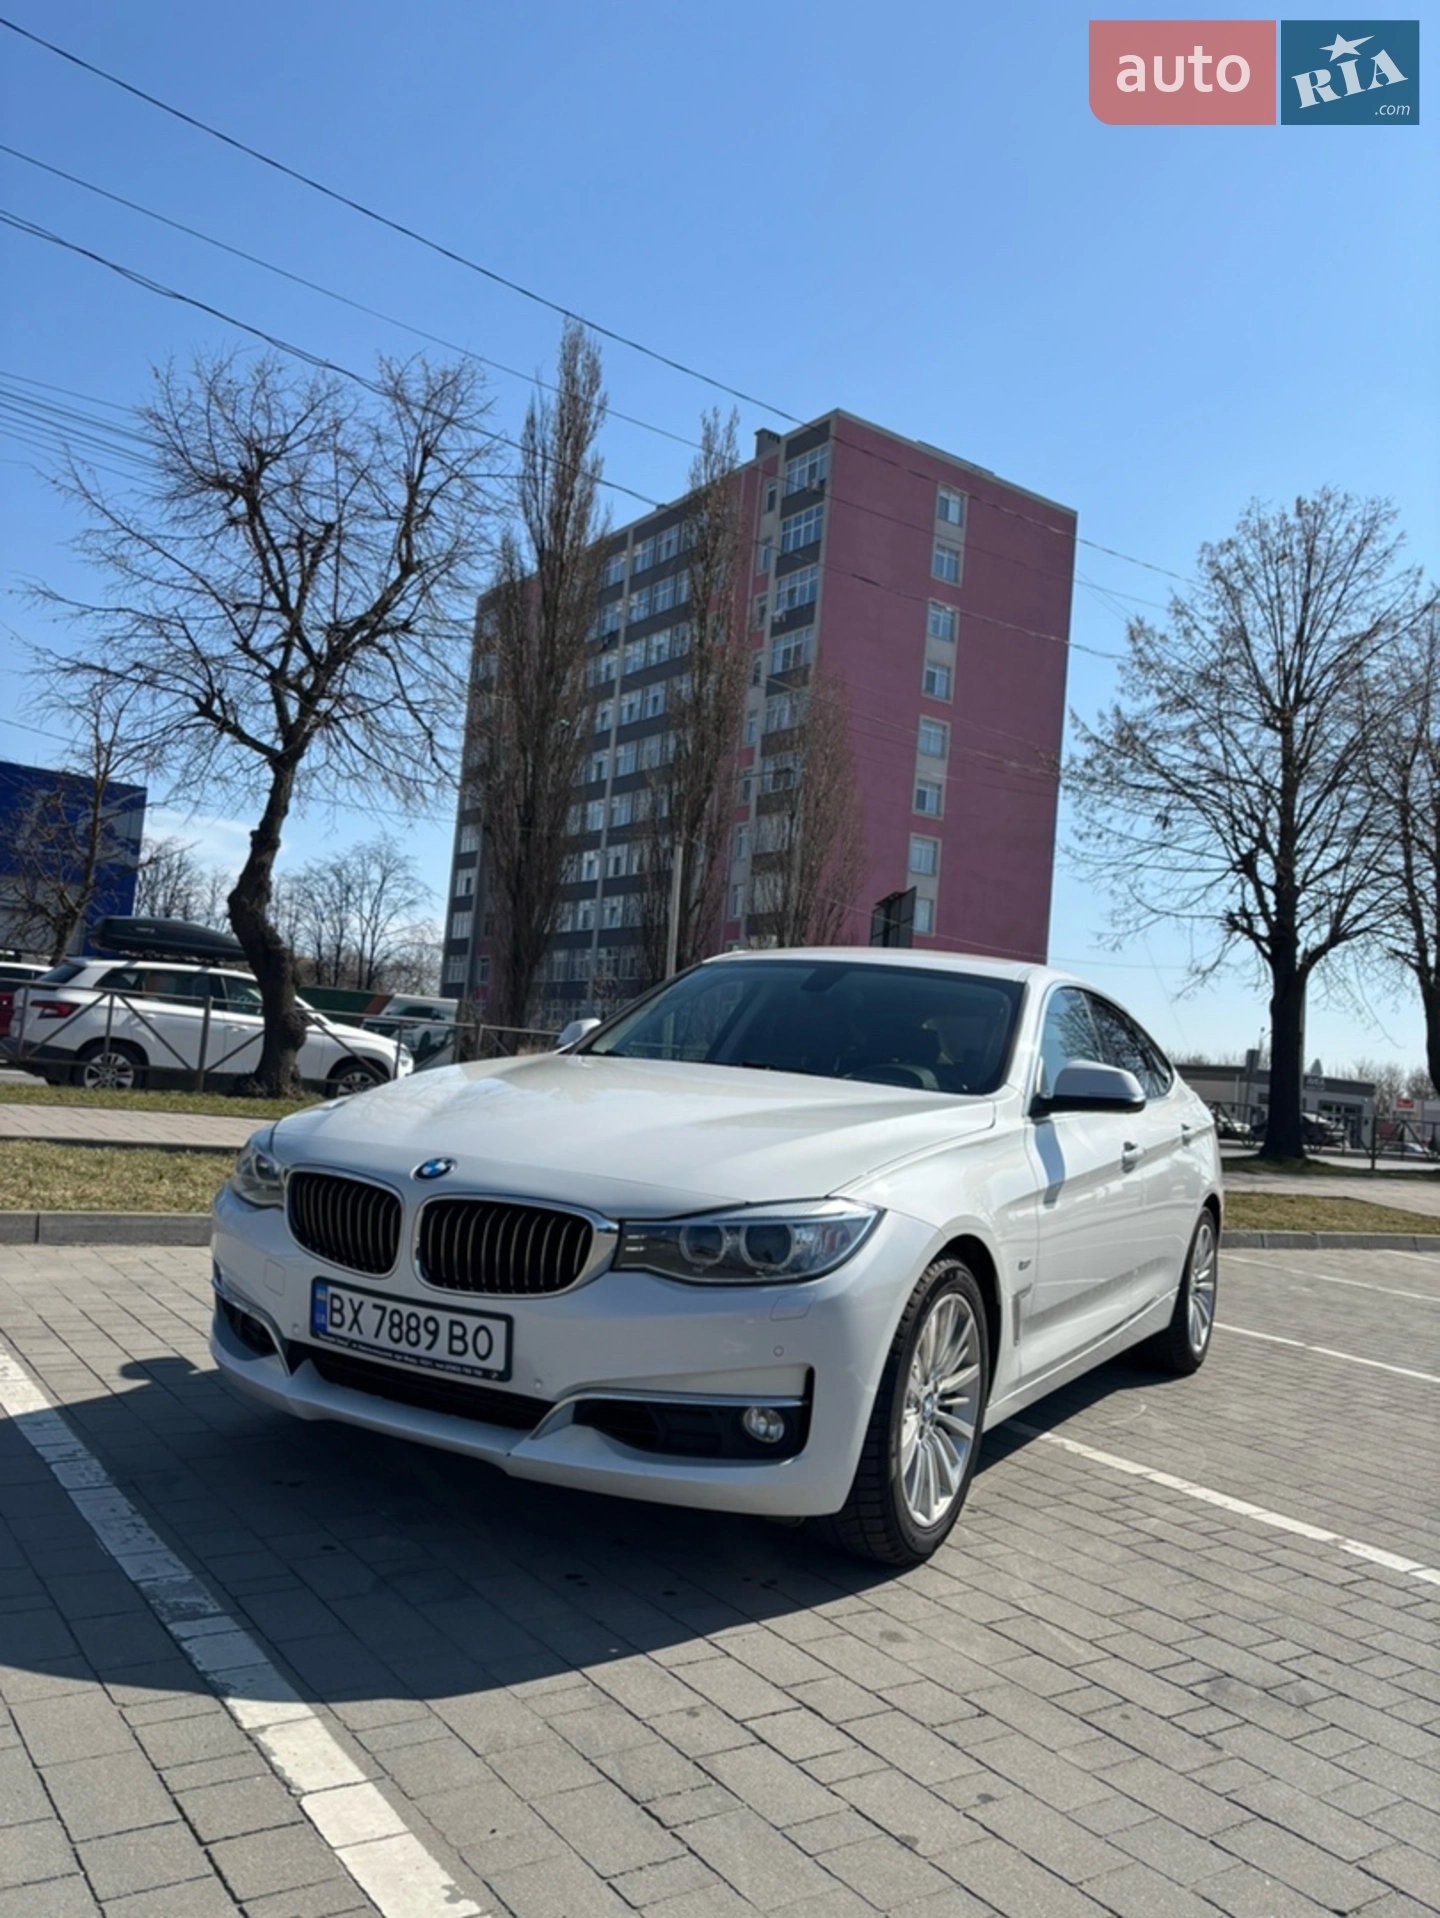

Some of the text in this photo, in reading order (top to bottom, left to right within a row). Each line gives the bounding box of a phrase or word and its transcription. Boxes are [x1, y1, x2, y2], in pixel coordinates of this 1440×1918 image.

[329, 1293, 494, 1361] BX 7889 BO
